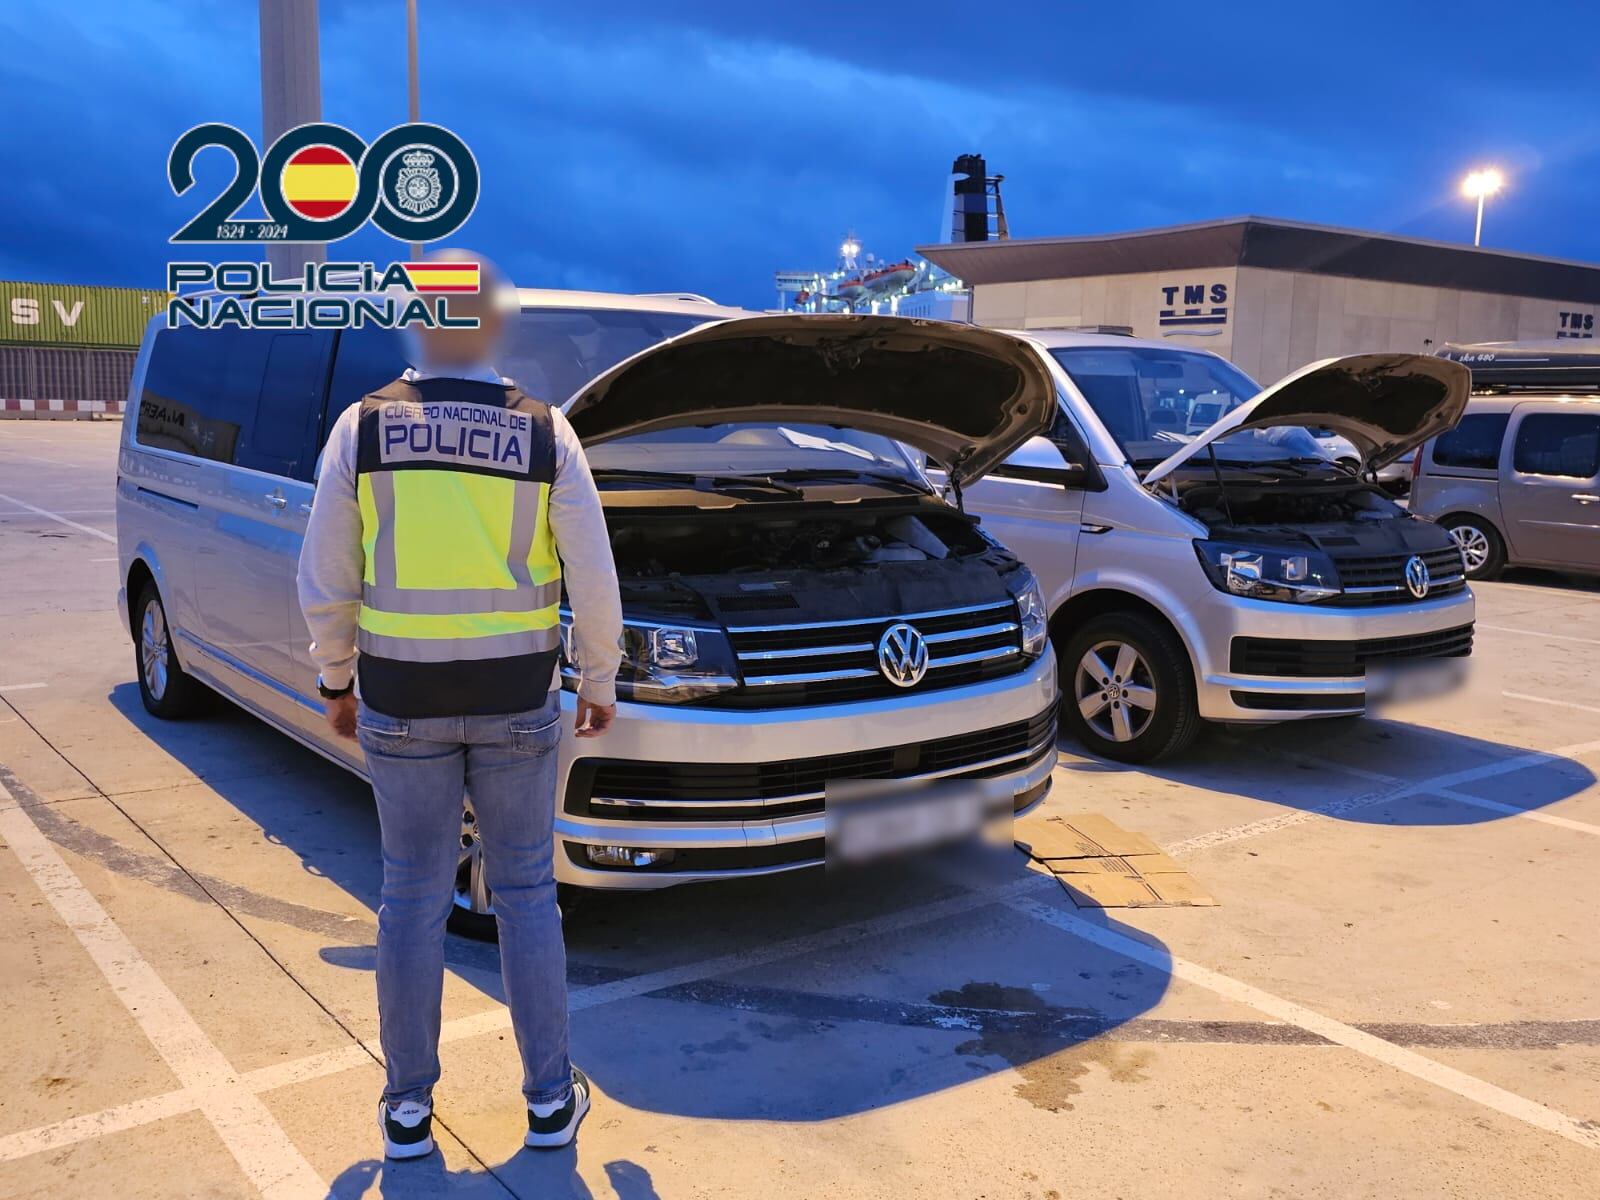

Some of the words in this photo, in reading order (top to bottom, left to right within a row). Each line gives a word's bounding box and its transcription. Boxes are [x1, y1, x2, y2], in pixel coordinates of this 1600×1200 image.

[1161, 283, 1228, 306] TMS
[1559, 311, 1594, 330] TMS
[384, 405, 440, 420] CUERPO
[443, 405, 507, 428] NACIONAL
[509, 414, 527, 432] DE
[384, 423, 524, 466] POLICIA
